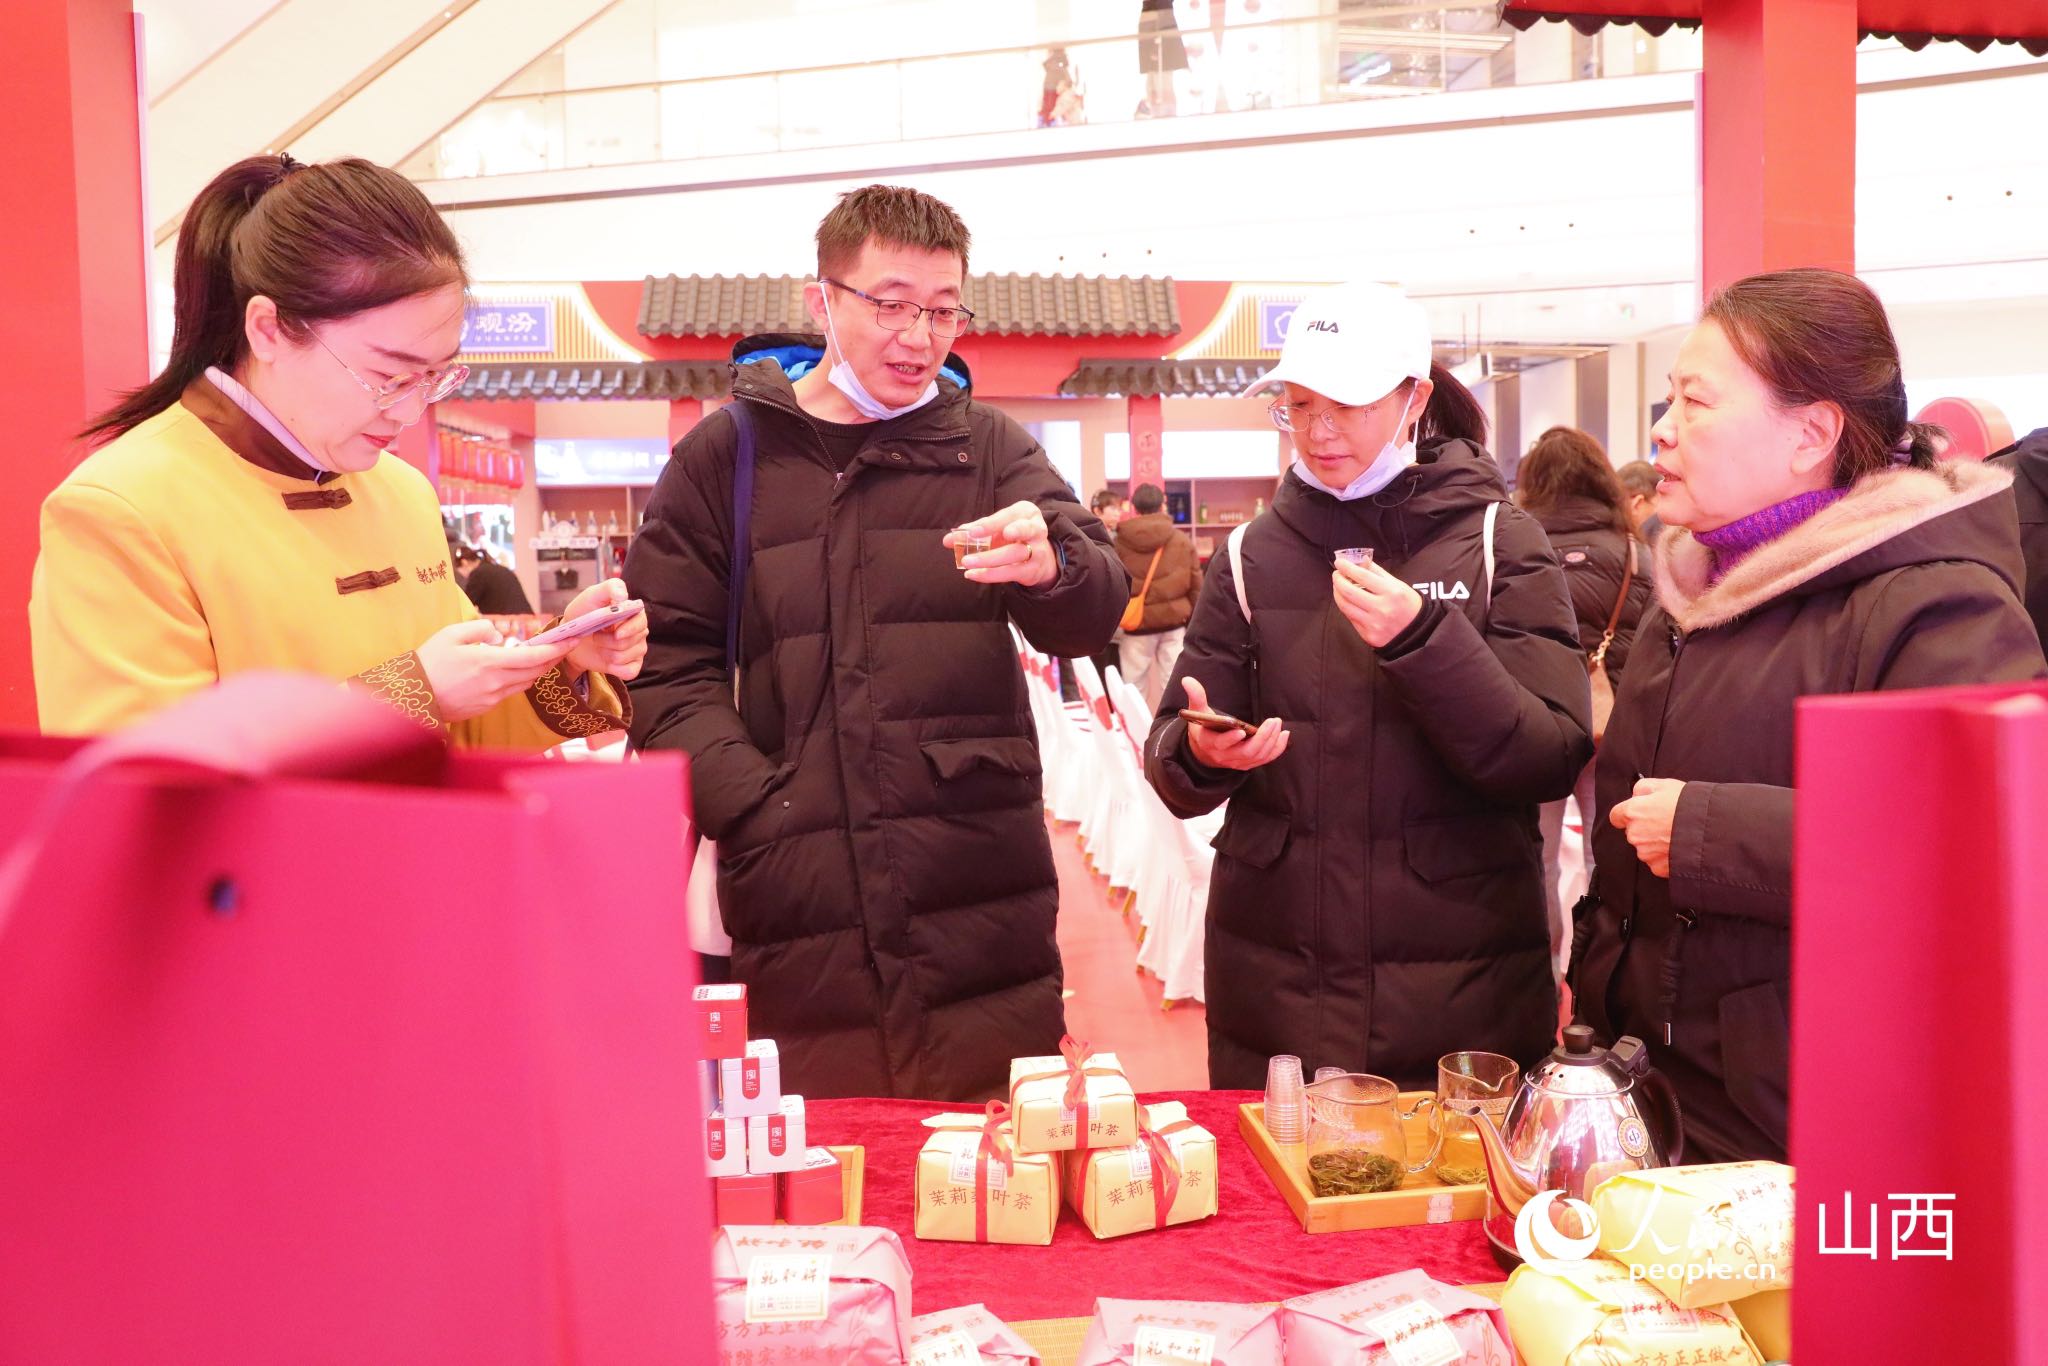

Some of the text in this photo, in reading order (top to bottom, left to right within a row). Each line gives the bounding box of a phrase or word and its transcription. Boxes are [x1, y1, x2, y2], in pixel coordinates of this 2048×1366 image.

[475, 311, 538, 334] 观汾
[1307, 320, 1339, 333] FILA
[1412, 580, 1470, 600] FILA
[1046, 1123, 1119, 1141] 茉莉叶茶
[1105, 1169, 1202, 1207] 茉莉茶
